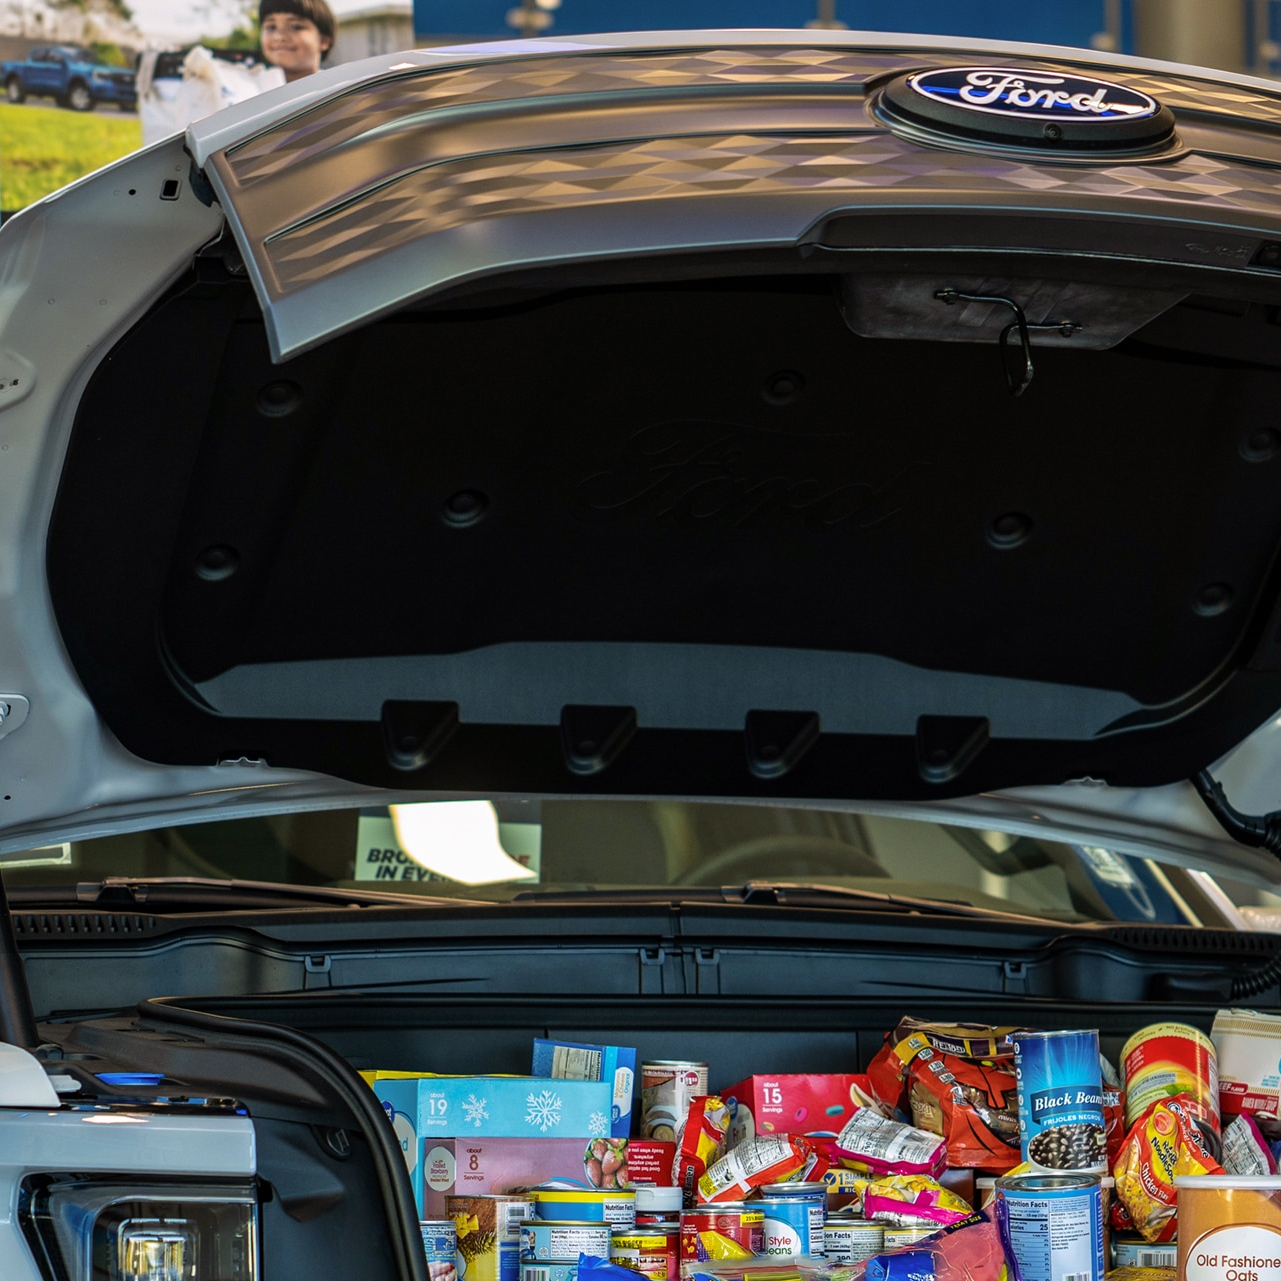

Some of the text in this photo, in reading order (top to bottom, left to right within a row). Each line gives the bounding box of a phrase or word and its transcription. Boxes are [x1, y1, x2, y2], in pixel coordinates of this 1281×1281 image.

[959, 70, 1112, 114] Ford
[375, 865, 398, 879] IN
[763, 1088, 782, 1103] 15
[1034, 1093, 1072, 1111] Black
[429, 1099, 447, 1116] 19
[1043, 1115, 1077, 1126] FRIJOLES
[469, 1154, 479, 1171] 8
[839, 1173, 844, 1185] 1
[769, 1236, 791, 1246] Style
[1196, 1254, 1218, 1267] Old
[1226, 1270, 1259, 1281] Oats
